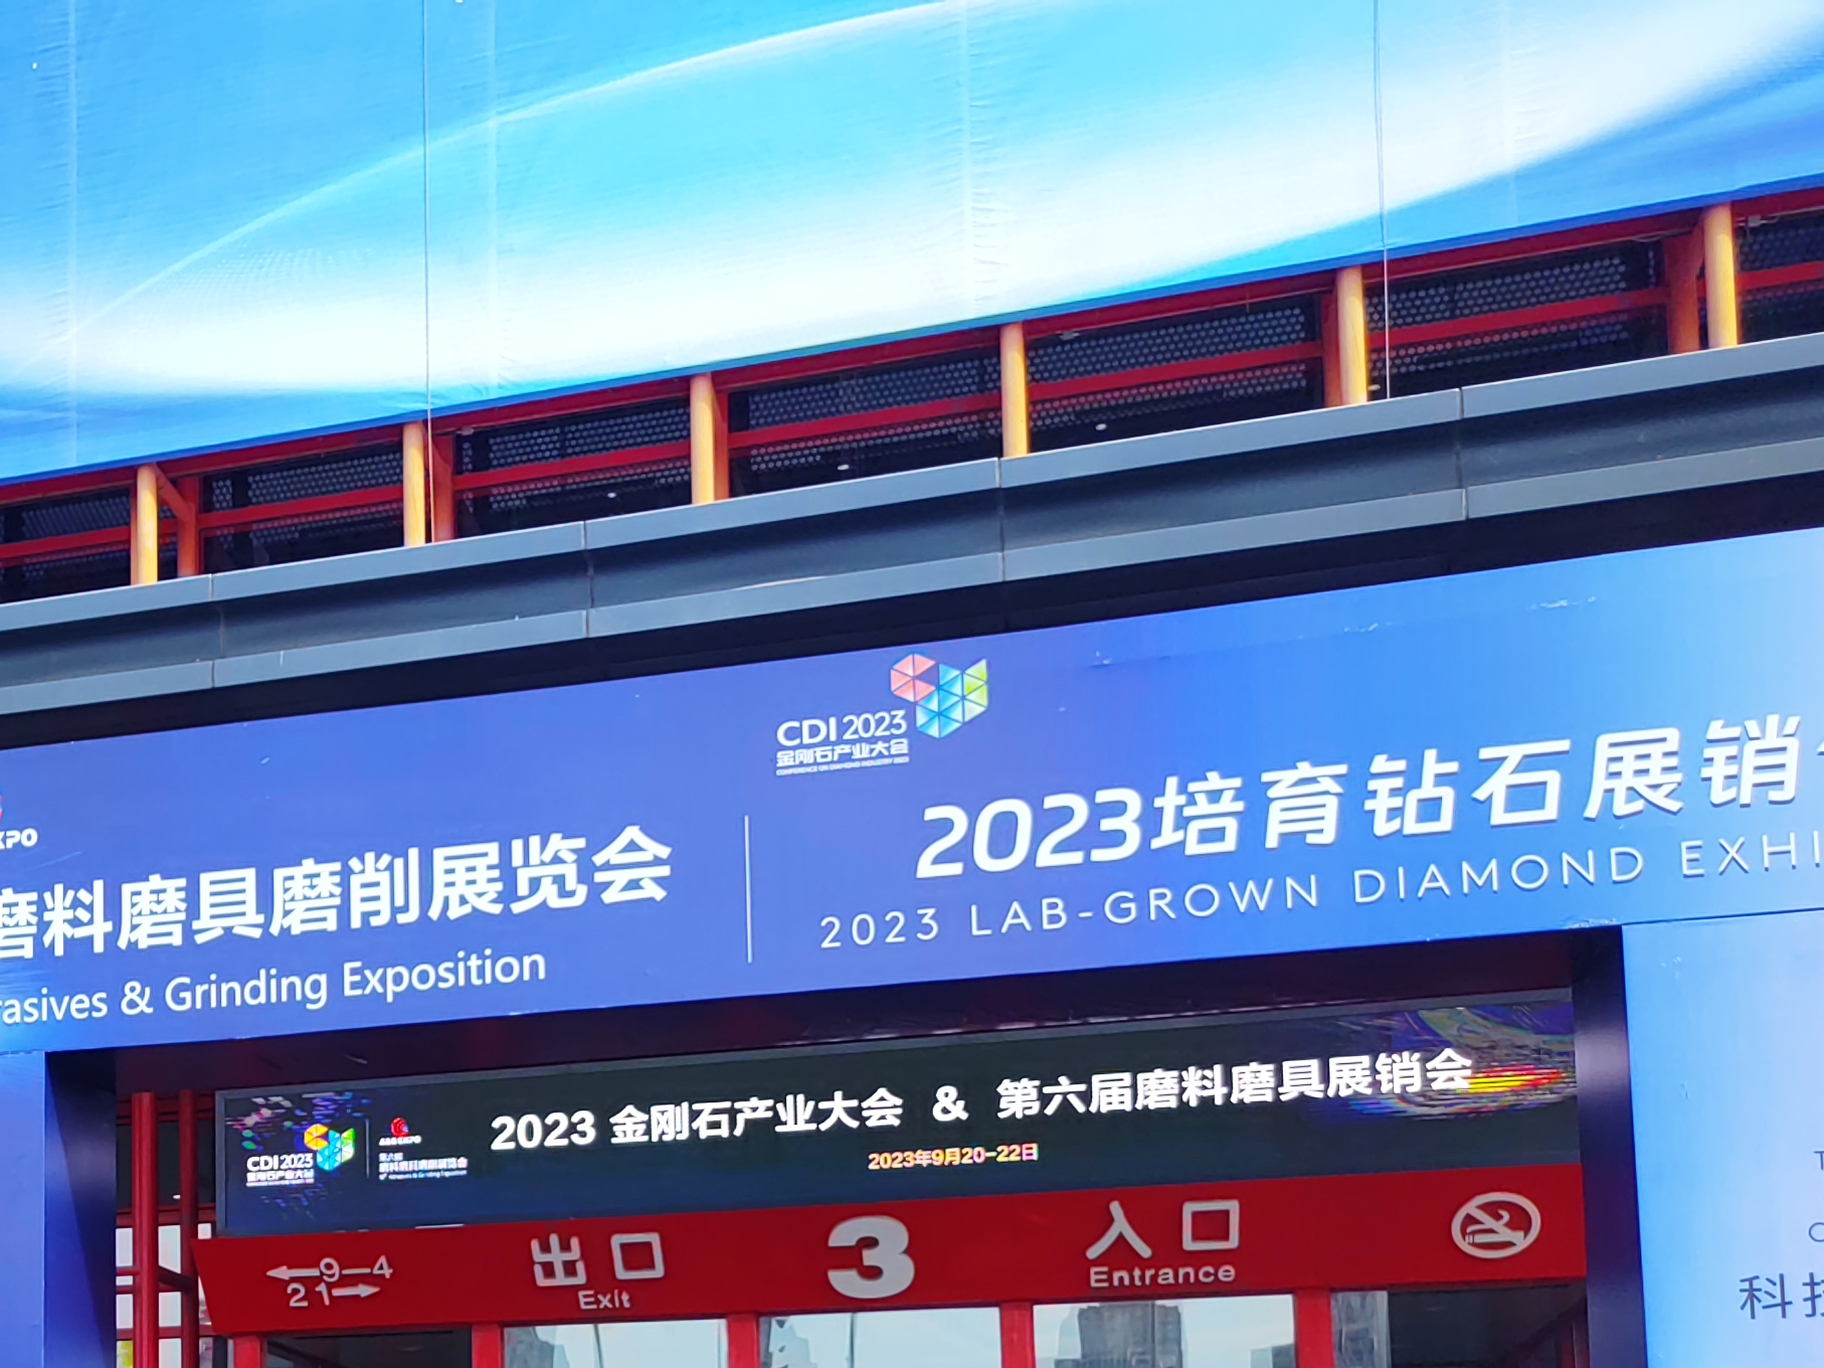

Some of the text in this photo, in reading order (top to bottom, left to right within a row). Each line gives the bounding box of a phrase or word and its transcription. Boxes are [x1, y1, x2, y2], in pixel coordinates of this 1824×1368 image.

[776, 738, 908, 767] 金刚石产业大会
[777, 709, 907, 747] CDI 2023
[916, 713, 1824, 879] 2023培育钻石展销
[820, 908, 940, 949] 2023
[970, 874, 1318, 936] LAB-GROWN
[1354, 847, 1643, 904] DIAMOND
[120, 981, 154, 1016] &
[165, 969, 327, 1011] Grinding
[343, 948, 547, 1002] Exposition
[490, 1047, 1473, 1152] 2023 金刚石产业大会 & 第六届磨料磨具展销会
[246, 1153, 314, 1172] CDI 2023
[867, 1142, 1039, 1171] 2023年9月20-22日
[827, 1214, 916, 1300] 3
[1085, 1199, 1240, 1260] 入口
[530, 1232, 666, 1288] 出口
[1090, 1264, 1236, 1288] Entrance
[578, 1289, 631, 1311] Exit
